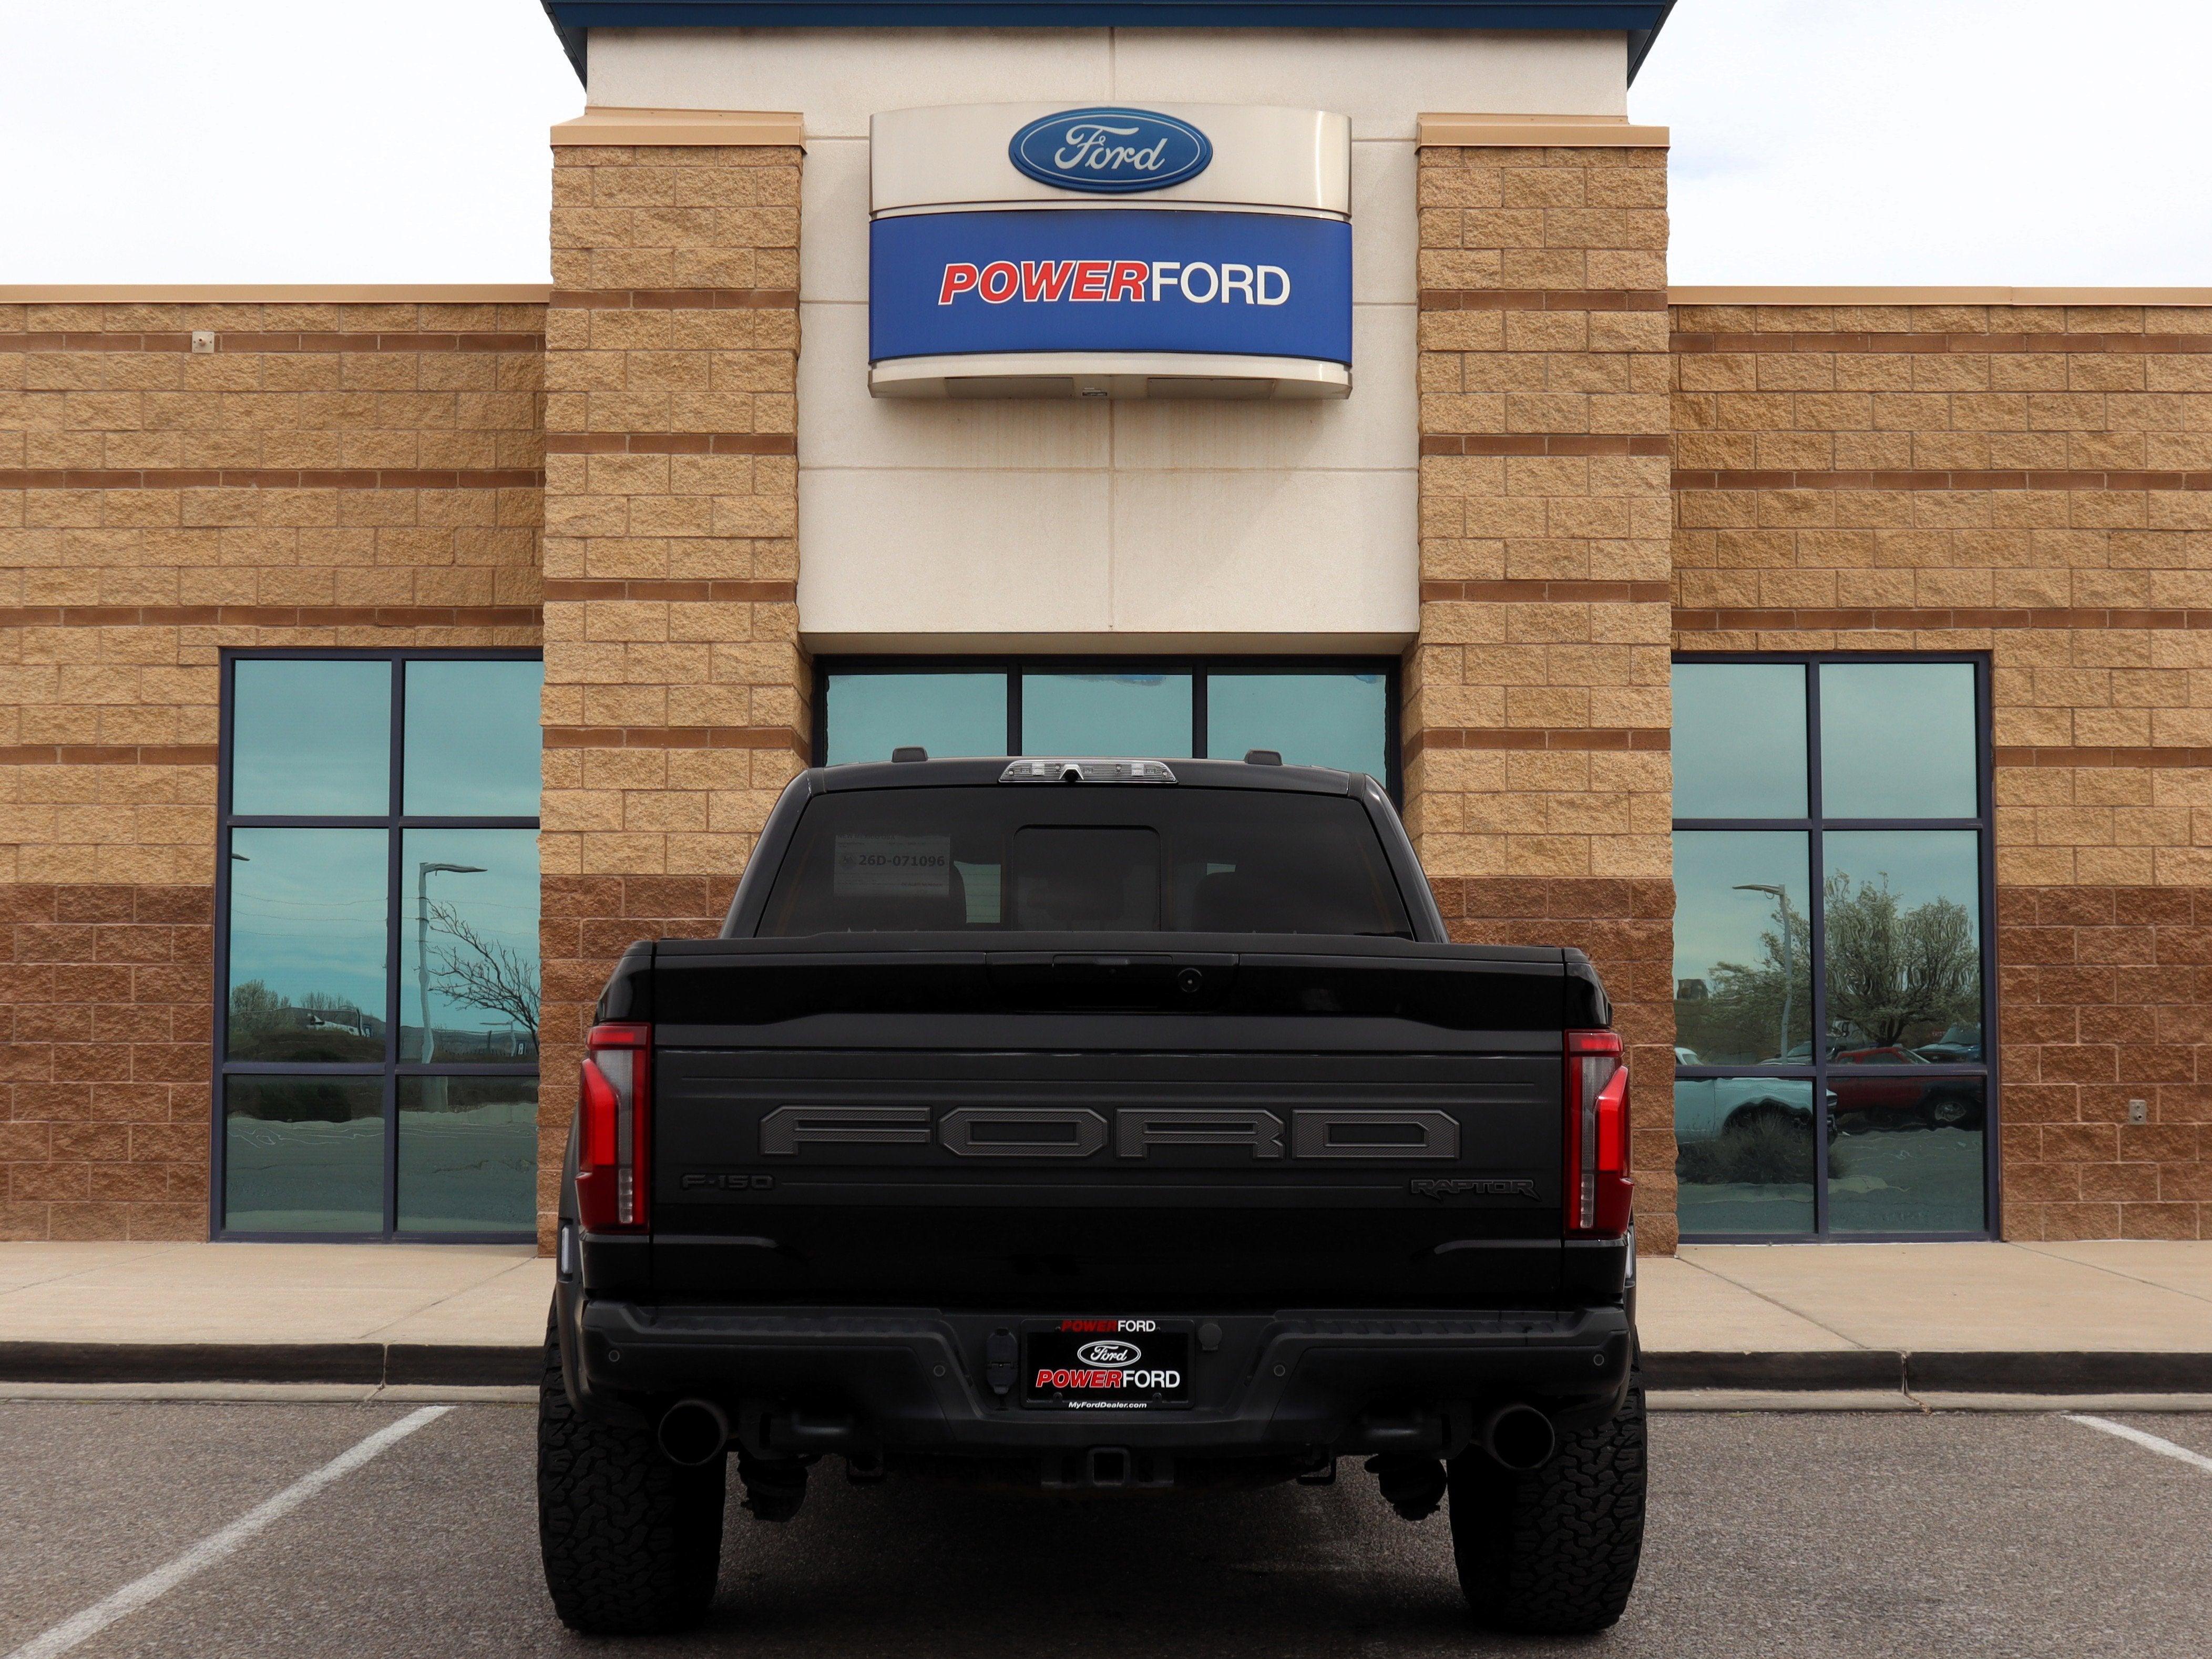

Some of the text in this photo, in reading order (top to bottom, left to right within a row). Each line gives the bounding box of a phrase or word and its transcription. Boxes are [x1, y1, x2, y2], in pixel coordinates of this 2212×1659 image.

[1053, 124, 1165, 171] Ford
[859, 855, 945, 867] 26D-071096
[760, 1104, 1461, 1160] FORD
[682, 1174, 773, 1189] F-150
[1411, 1179, 1542, 1202] RAPTOR
[1090, 1345, 1127, 1361] Ford
